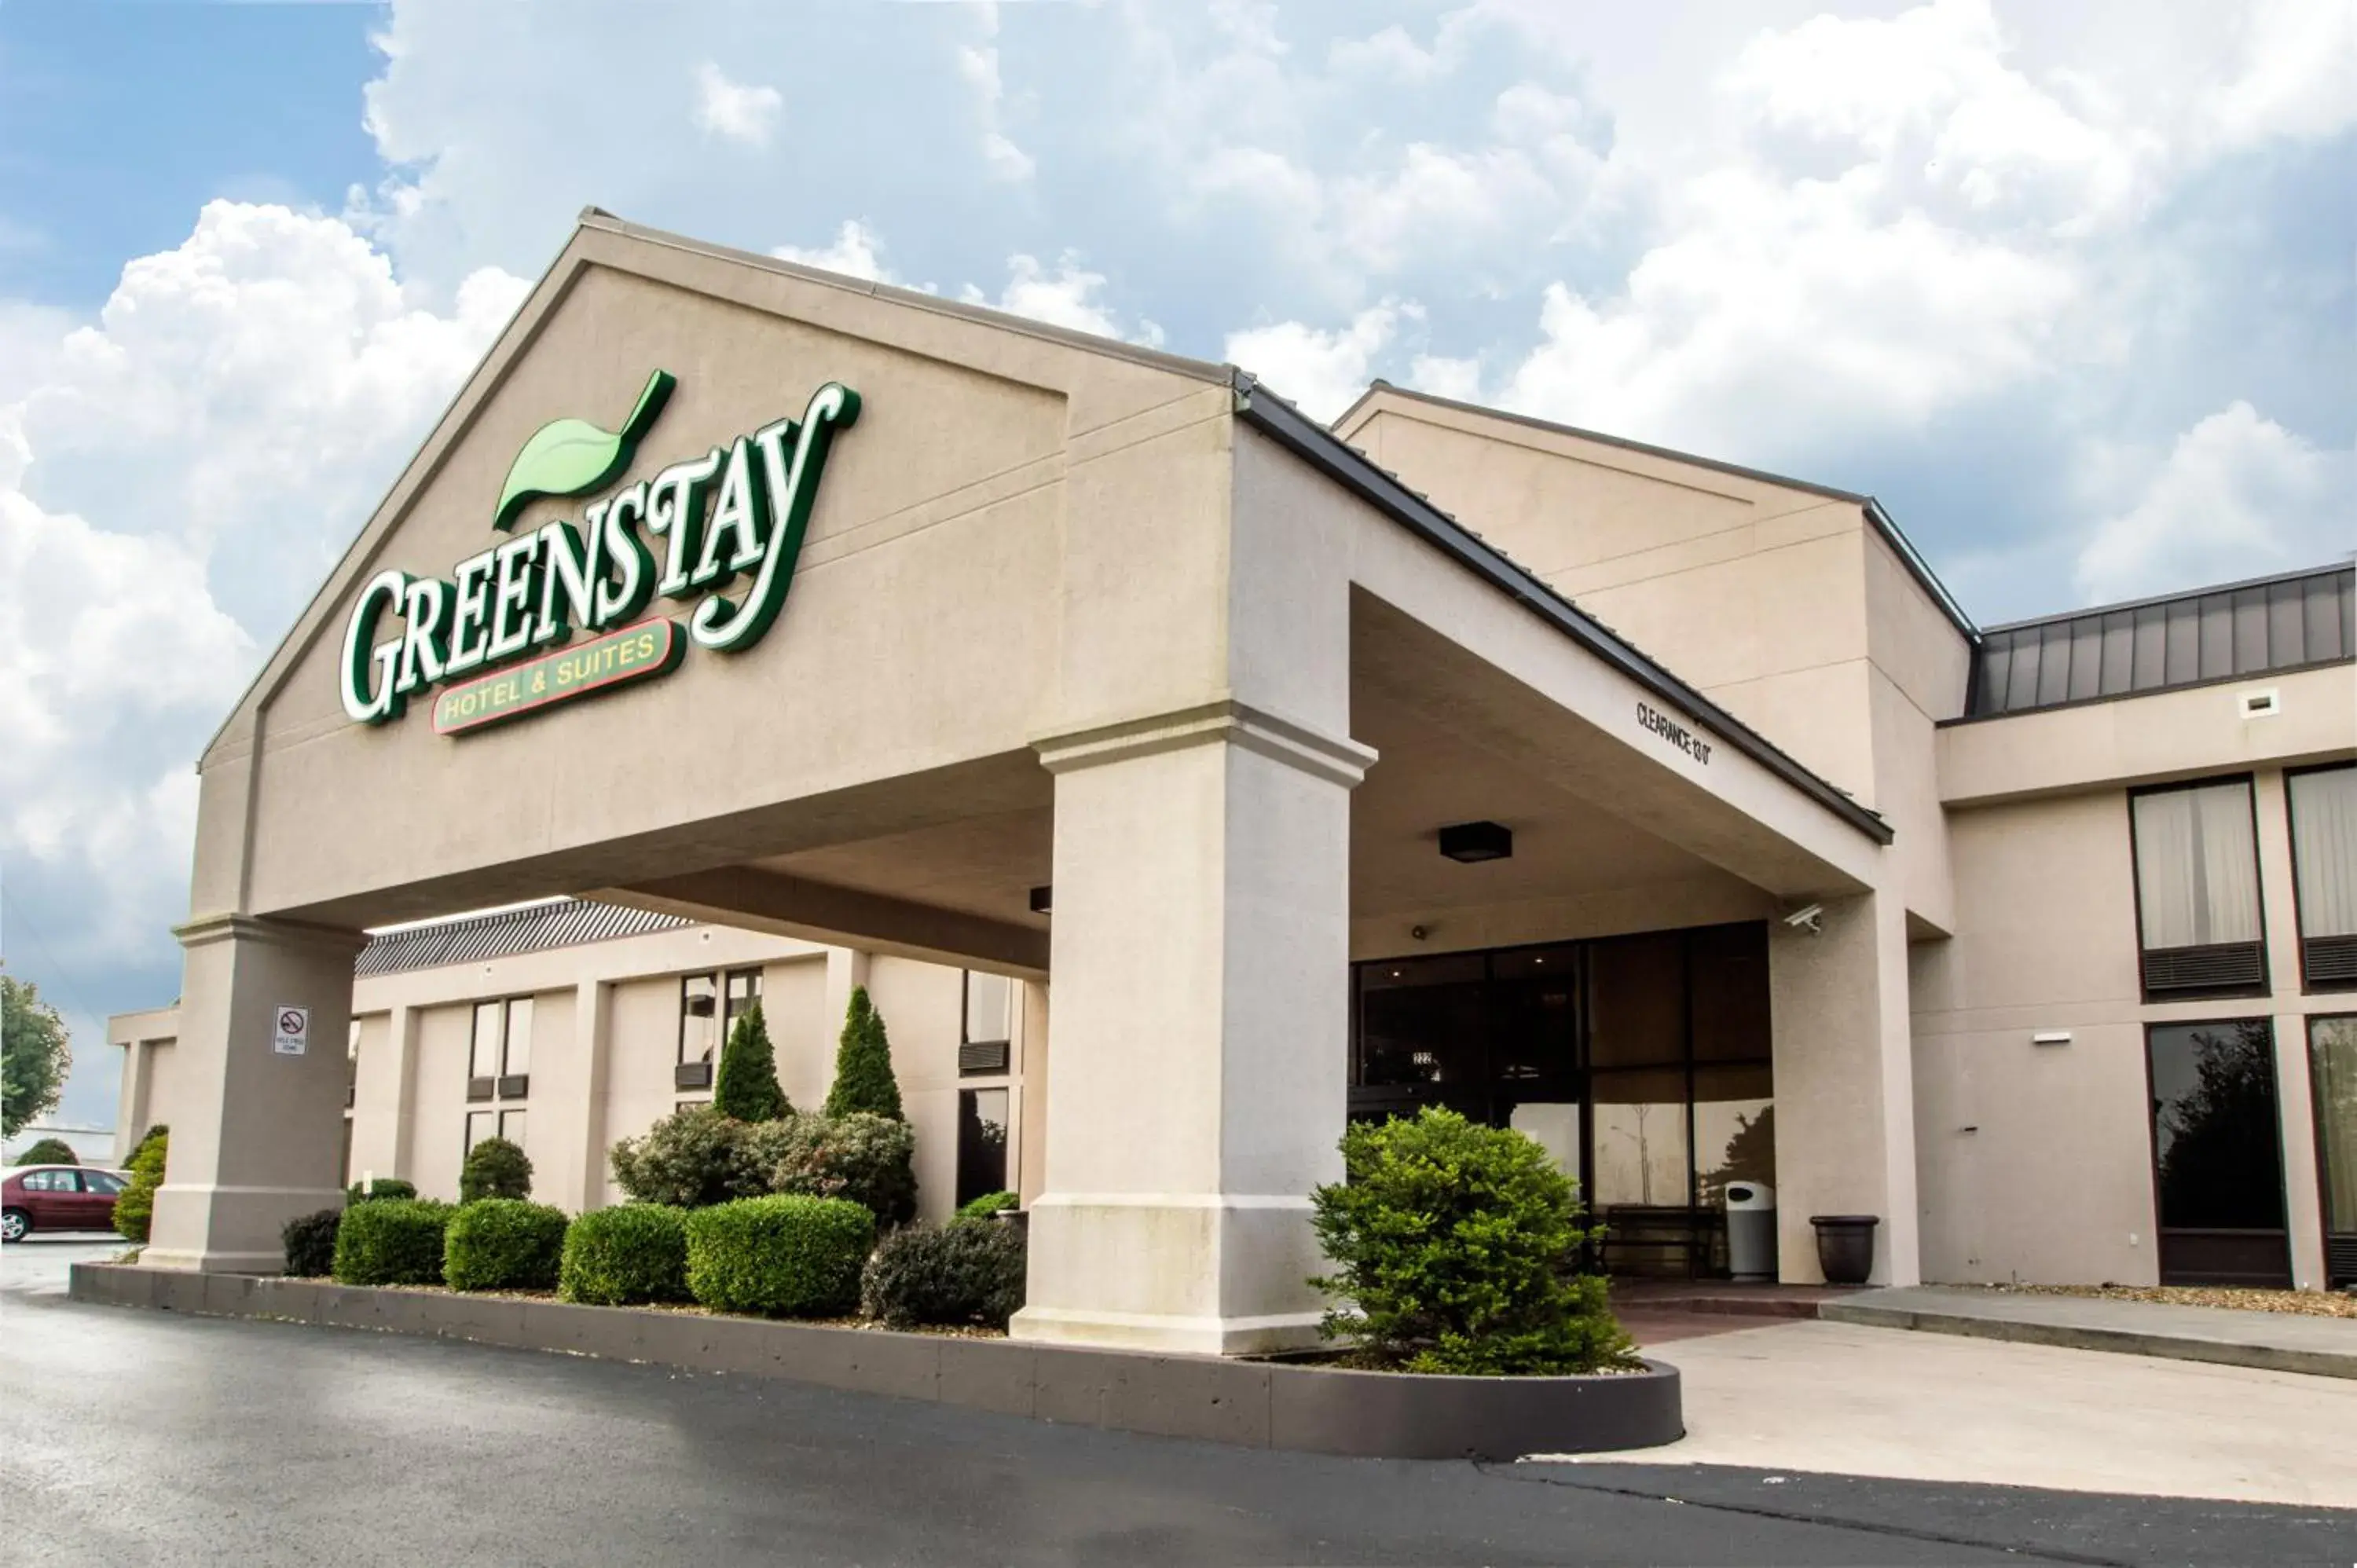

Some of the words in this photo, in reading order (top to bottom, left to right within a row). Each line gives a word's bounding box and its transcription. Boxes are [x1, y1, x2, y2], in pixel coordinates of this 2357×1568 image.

[339, 381, 849, 724] GREENSTAY
[444, 679, 521, 721] HOTEL
[530, 669, 547, 694] &
[556, 632, 654, 686] SUITES
[1637, 702, 1692, 756] CLEARANCE
